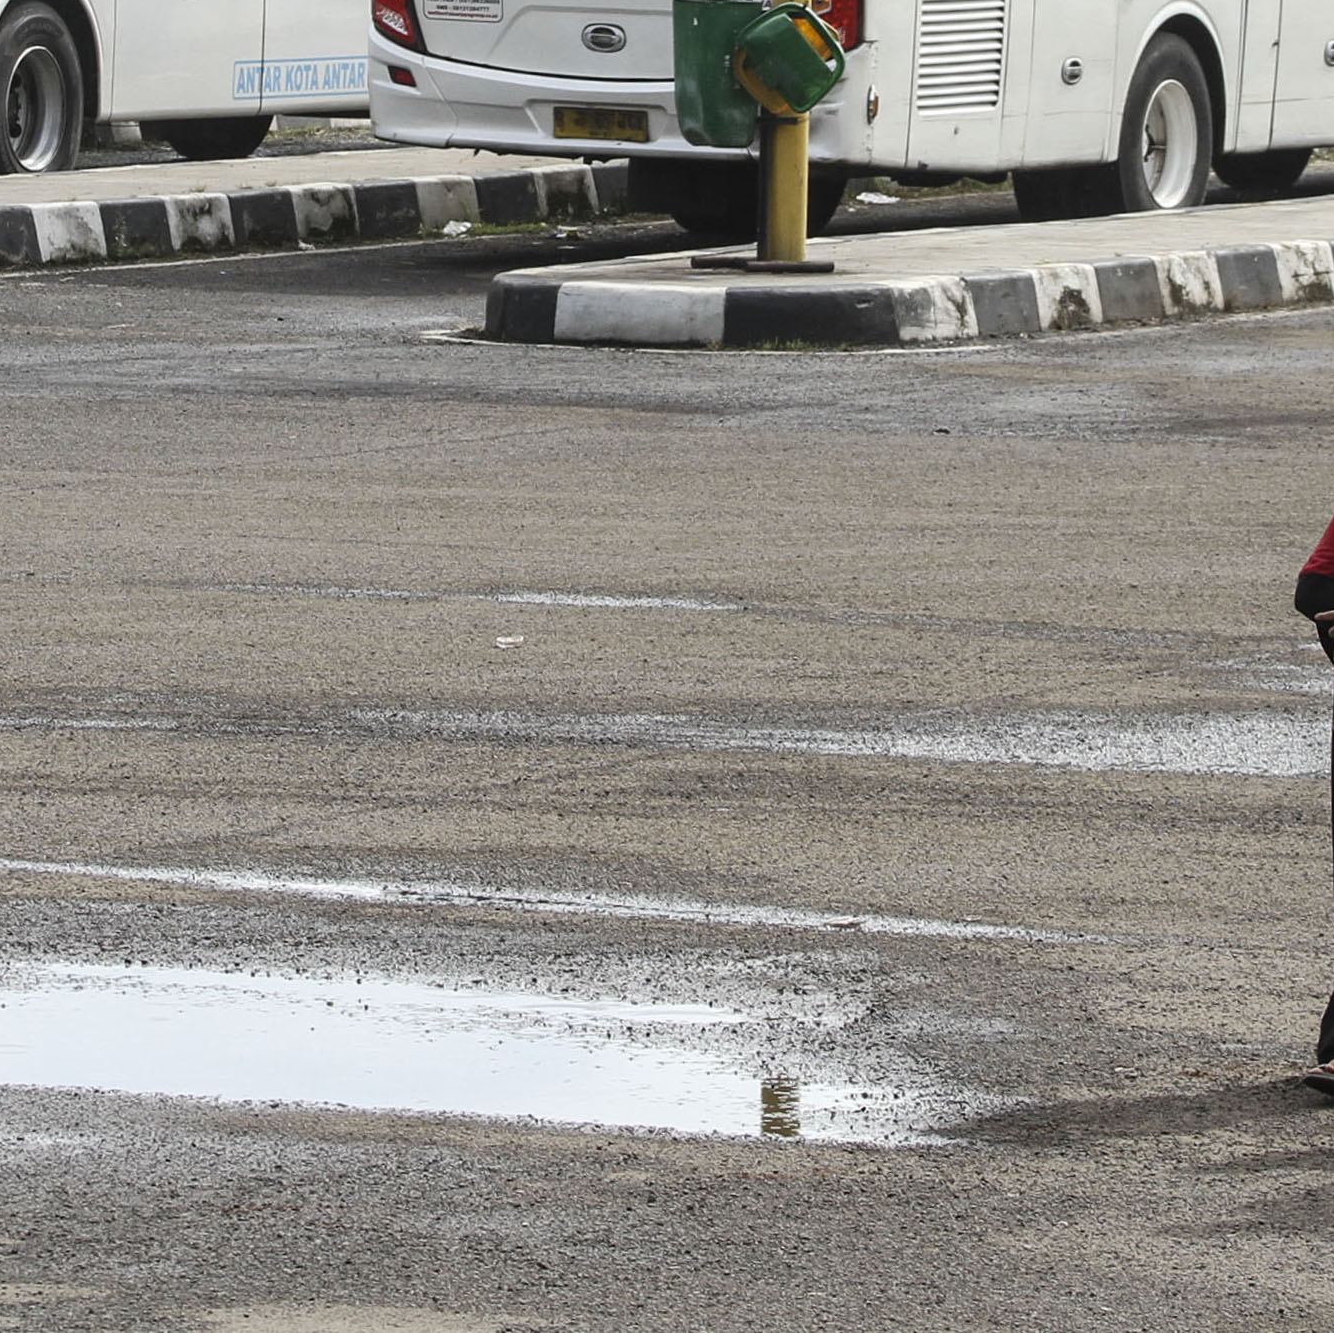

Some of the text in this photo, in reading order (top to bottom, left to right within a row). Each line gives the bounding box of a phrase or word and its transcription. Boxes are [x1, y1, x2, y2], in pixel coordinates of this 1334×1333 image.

[236, 62, 365, 94] ANTAR KOTA ANTAR
